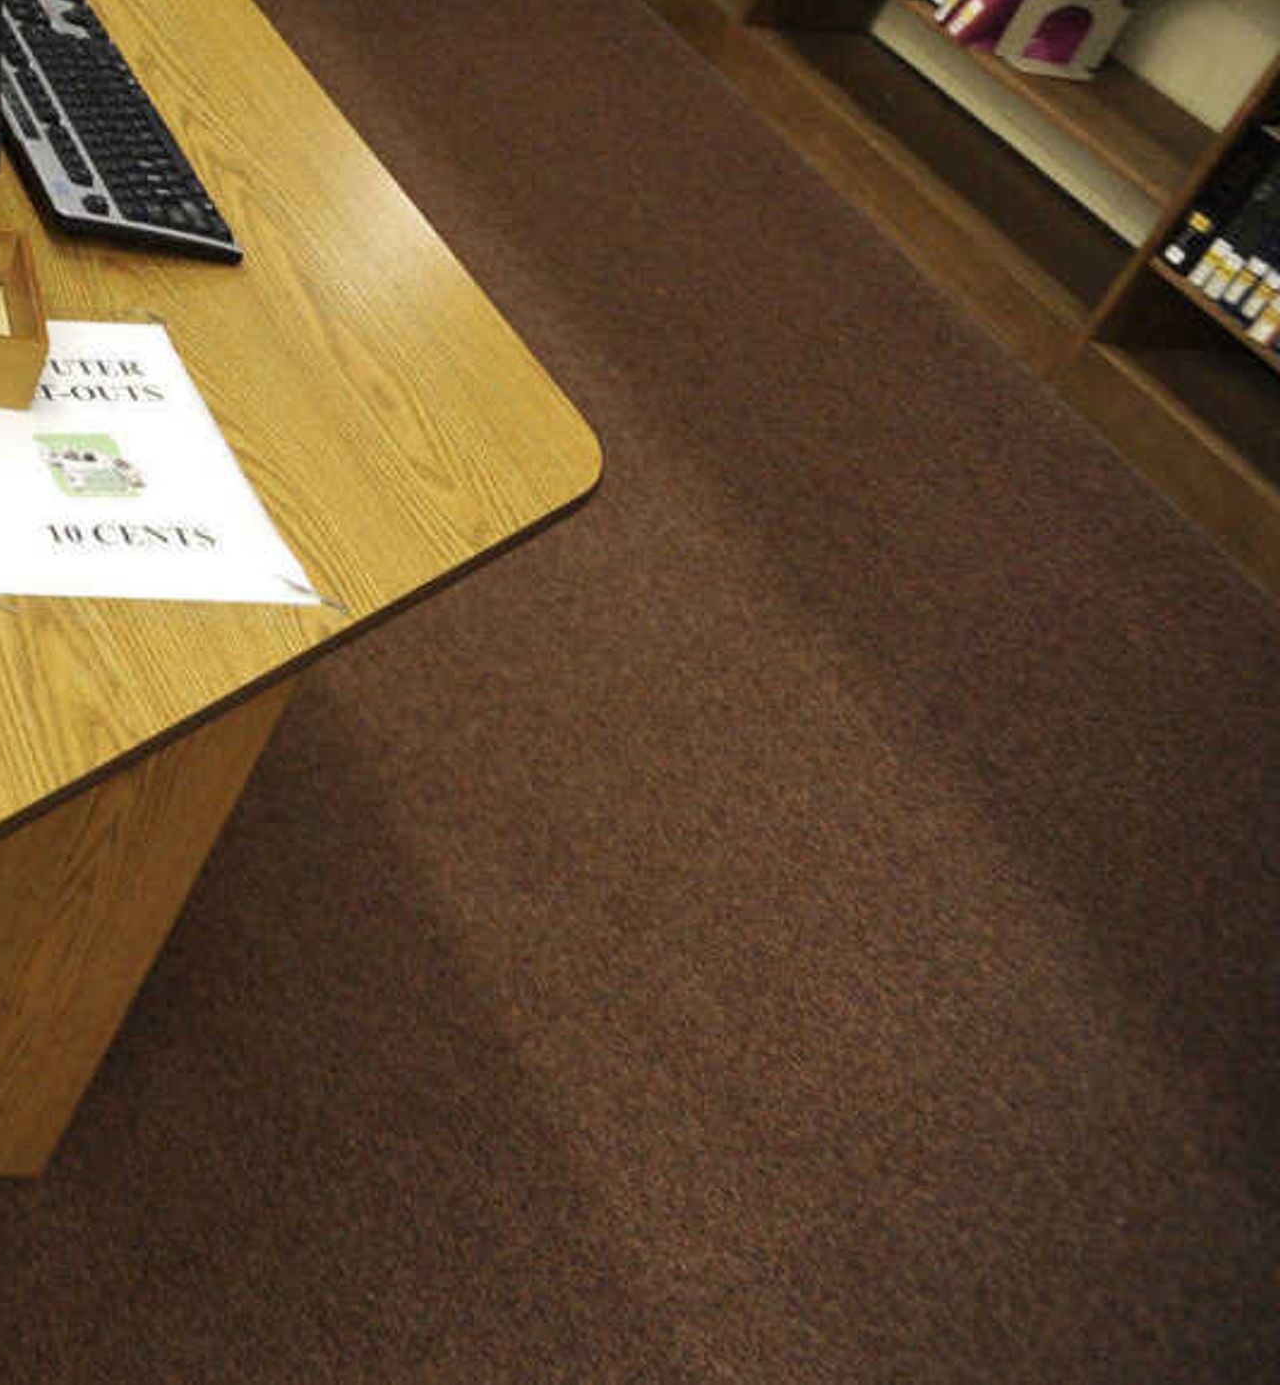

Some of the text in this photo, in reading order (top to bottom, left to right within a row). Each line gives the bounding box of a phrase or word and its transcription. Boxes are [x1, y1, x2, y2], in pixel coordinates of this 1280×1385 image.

[49, 358, 148, 377] UTER
[46, 521, 217, 548] 10 CENTS
